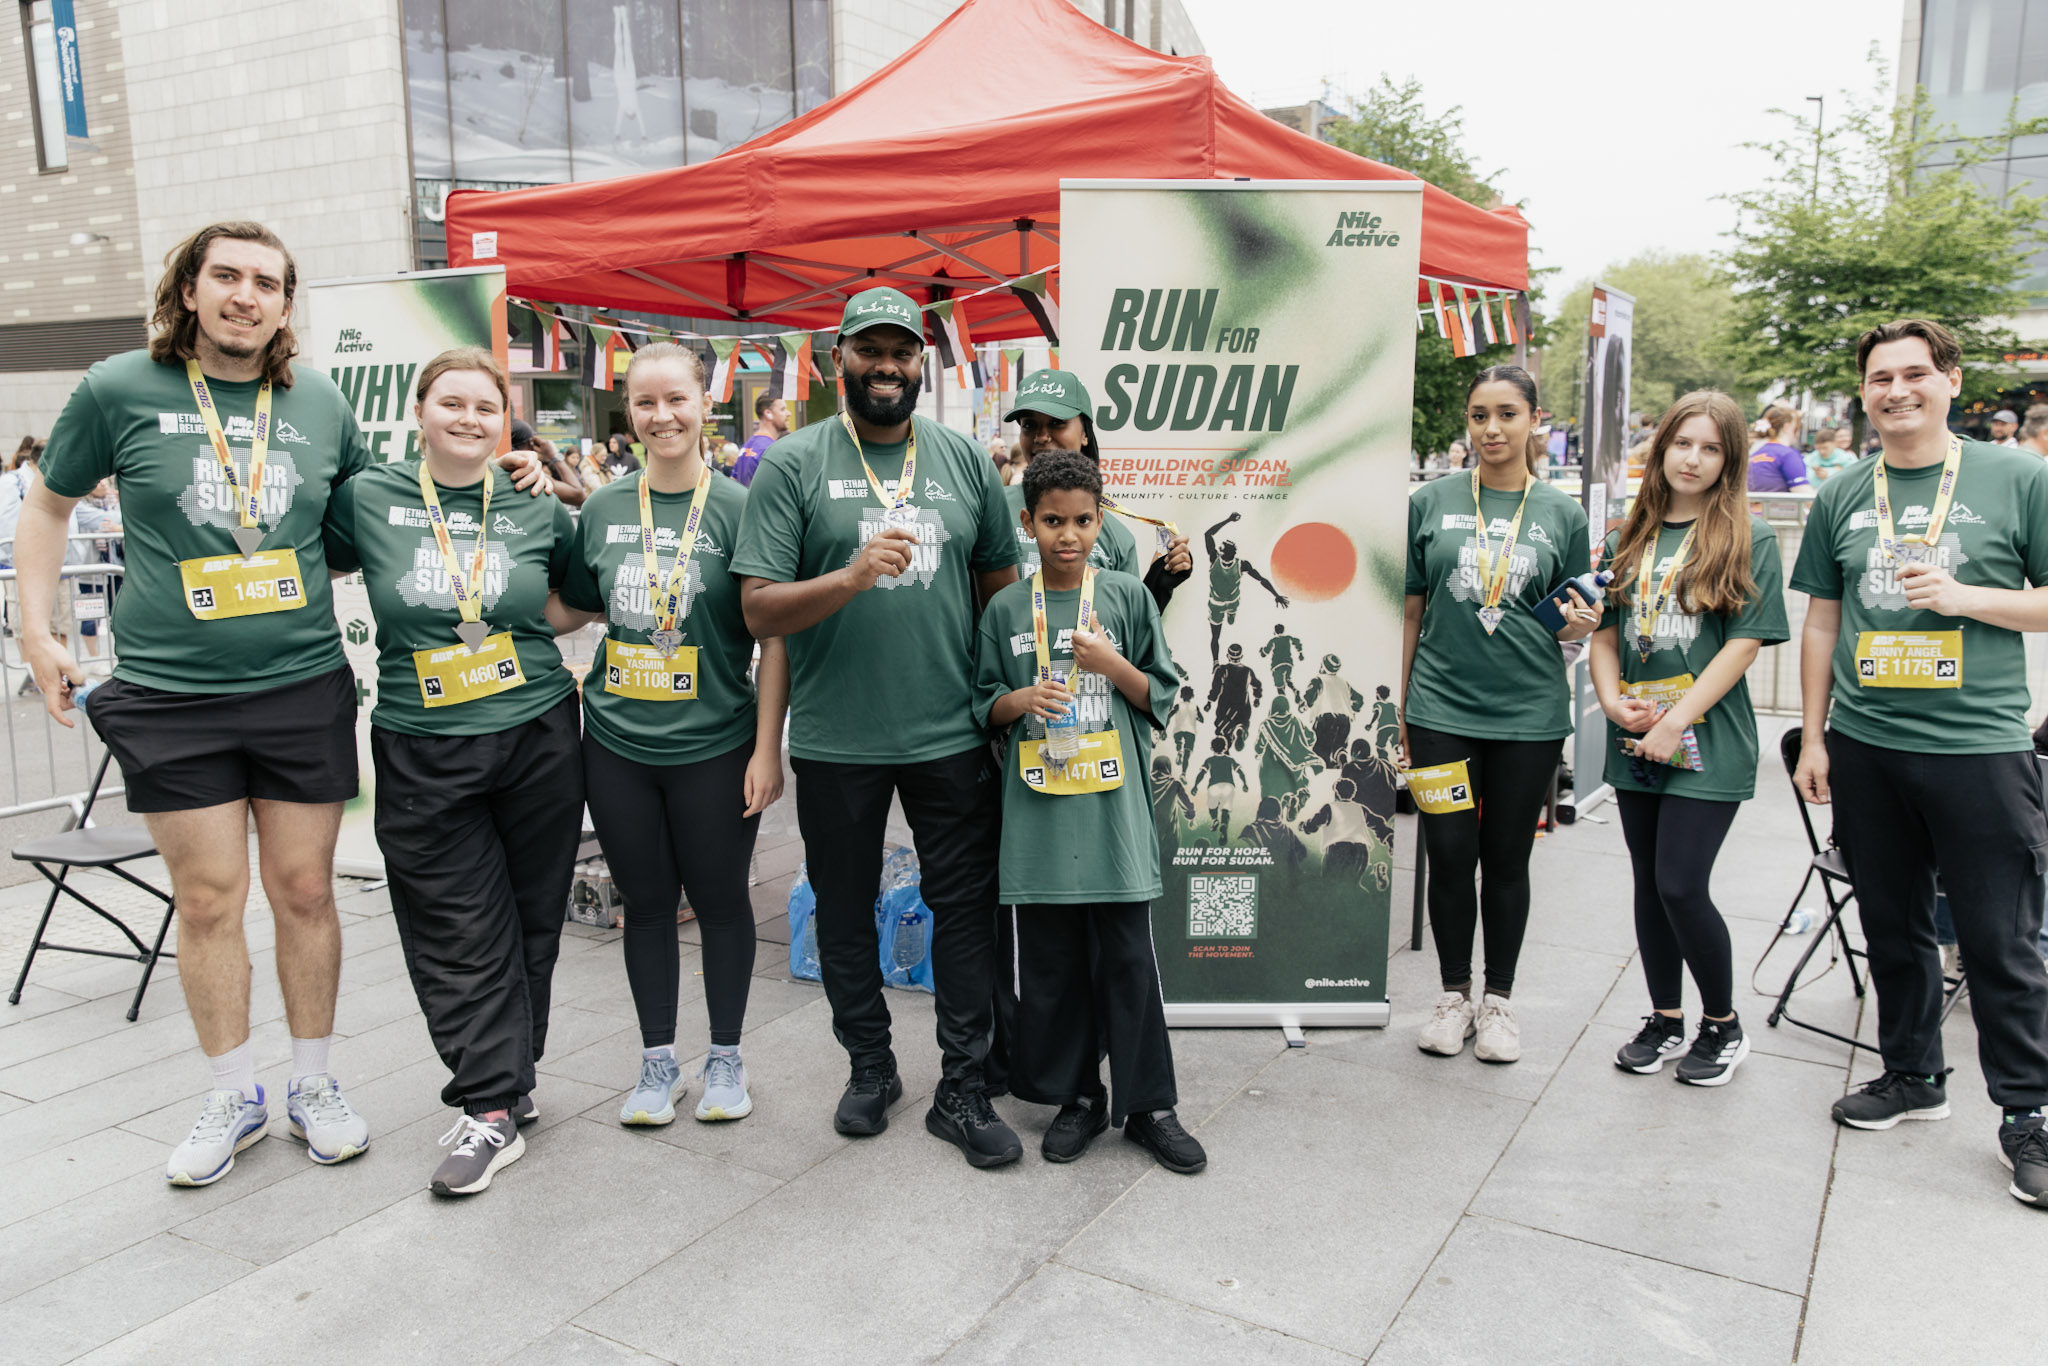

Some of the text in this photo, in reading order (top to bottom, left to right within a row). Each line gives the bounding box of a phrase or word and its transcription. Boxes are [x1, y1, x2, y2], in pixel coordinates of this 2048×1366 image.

[1337, 211, 1382, 229] Nile
[1326, 229, 1400, 247] Active
[1100, 288, 1260, 353] RUN FOR
[339, 328, 362, 341] Nile
[334, 340, 373, 353] Active
[331, 362, 417, 422] WHY
[1096, 363, 1300, 431] SUDAN
[178, 413, 205, 424] ETHA
[1098, 458, 1291, 474] REBUILDING SUDAN,
[842, 479, 867, 489] ETHAR
[1100, 473, 1292, 487] ONE MILE AT A TIME.
[844, 488, 868, 498] RELIEF
[1104, 492, 1164, 500] OMMUNITY
[405, 507, 430, 518] ETHA
[464, 552, 501, 571] FR
[1508, 554, 1530, 575] OR
[1923, 546, 1950, 568] OR
[415, 568, 502, 595] SUN
[234, 580, 277, 601] 1457
[1020, 632, 1036, 644] ETH
[1869, 646, 1944, 657] SUNNY ANGEL
[626, 658, 665, 671] YASMIN
[1878, 658, 1933, 675] E 1175
[458, 664, 497, 688] 1460
[622, 668, 670, 688] E 1108
[1041, 665, 1050, 682] 20
[1063, 761, 1097, 782] 1471
[1418, 787, 1450, 804] 1644
[1177, 847, 1271, 856] RUN FOR HOPE.
[1172, 857, 1275, 865] RUN FOR SUDAN.
[1304, 977, 1371, 989] @nile.active
